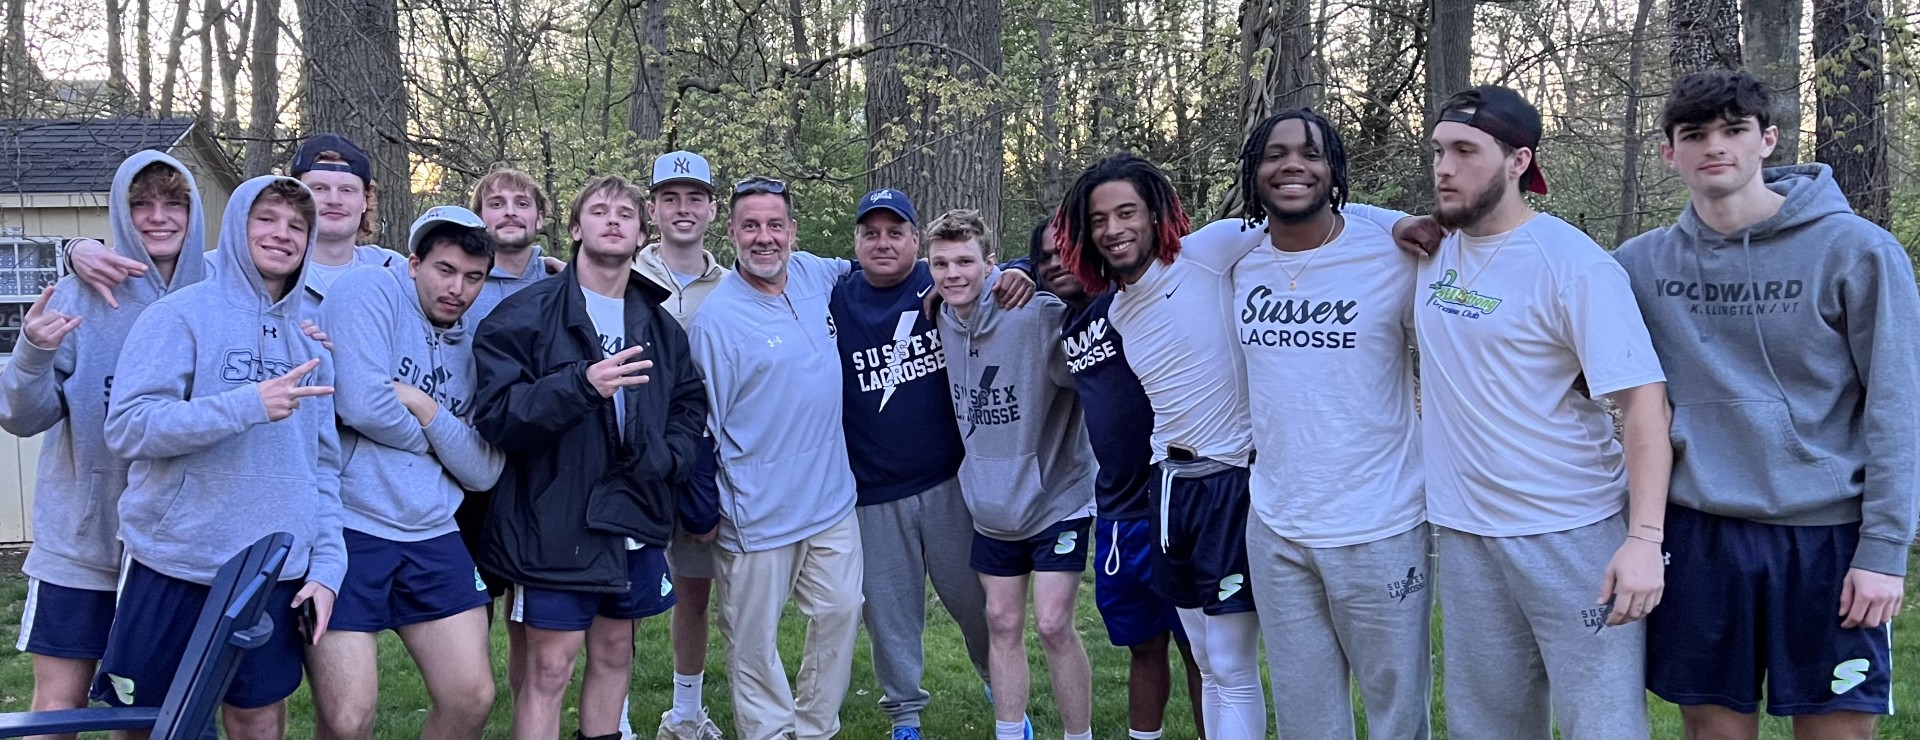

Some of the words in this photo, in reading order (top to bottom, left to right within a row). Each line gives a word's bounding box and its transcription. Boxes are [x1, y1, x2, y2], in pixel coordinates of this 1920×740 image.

[1241, 285, 1359, 325] Sussex
[1782, 302, 1799, 313] VT
[852, 328, 943, 371] SUSSEX
[1241, 328, 1357, 349] LACROSSE
[857, 349, 946, 392] LACROSSE
